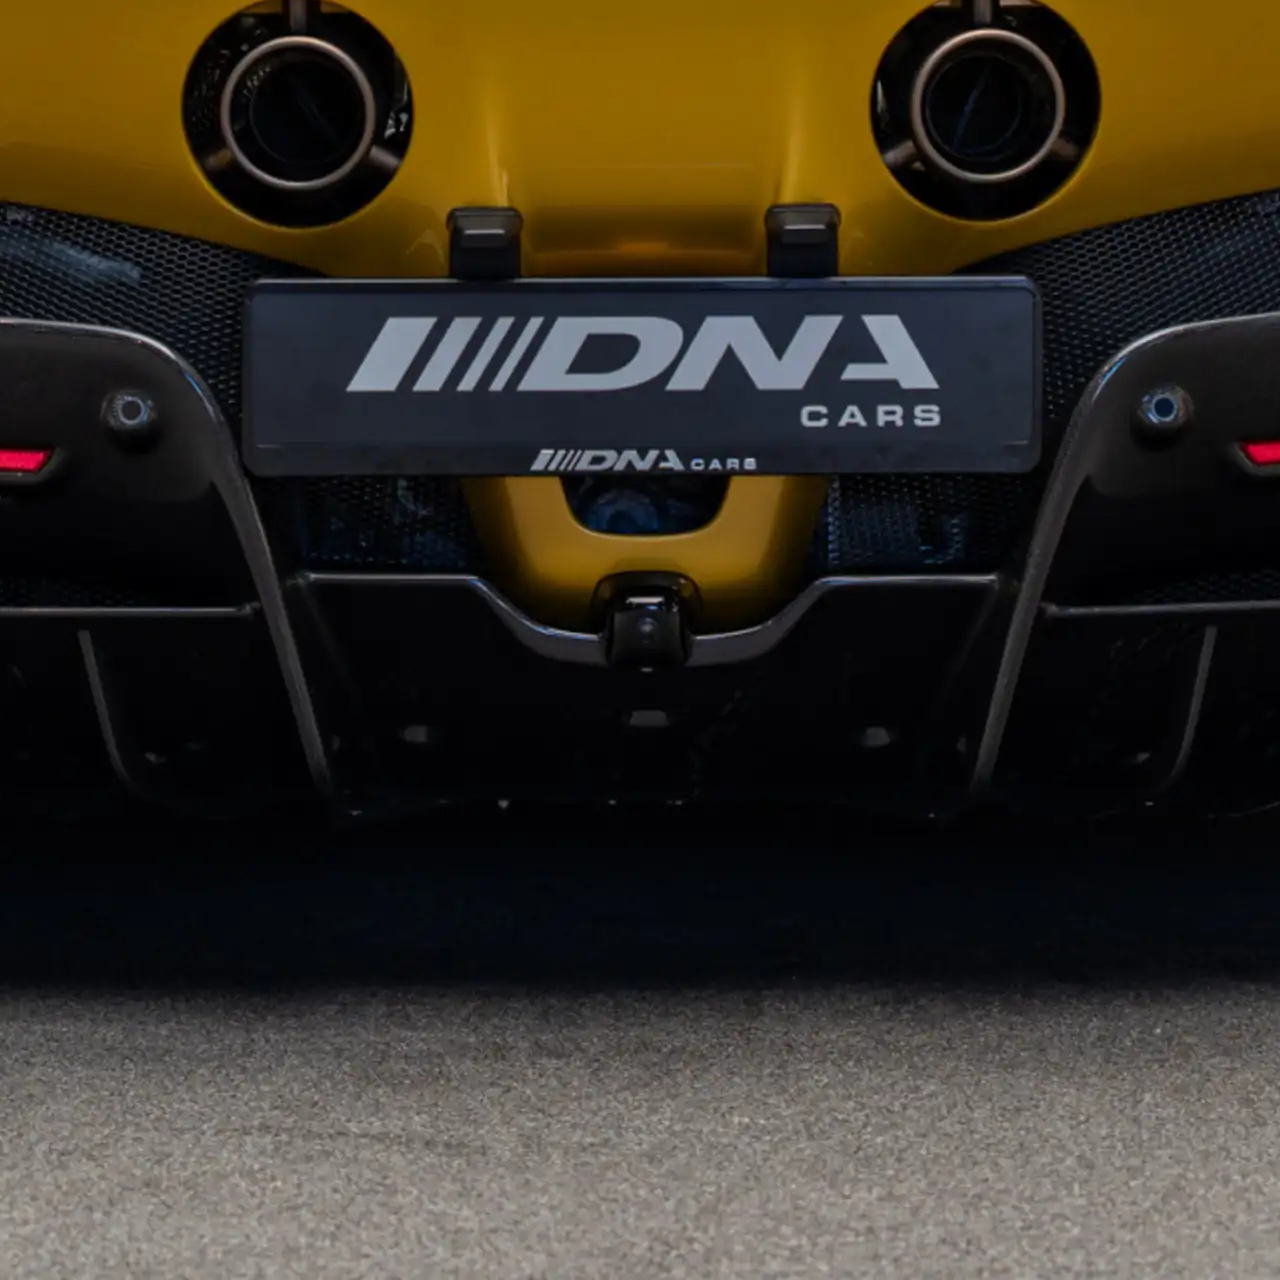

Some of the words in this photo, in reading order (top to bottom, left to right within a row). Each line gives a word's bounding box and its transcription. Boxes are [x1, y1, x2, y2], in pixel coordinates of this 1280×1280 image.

[516, 314, 940, 392] DNA
[800, 404, 941, 428] CARS
[574, 449, 685, 472] DNA
[689, 457, 758, 471] CARS
